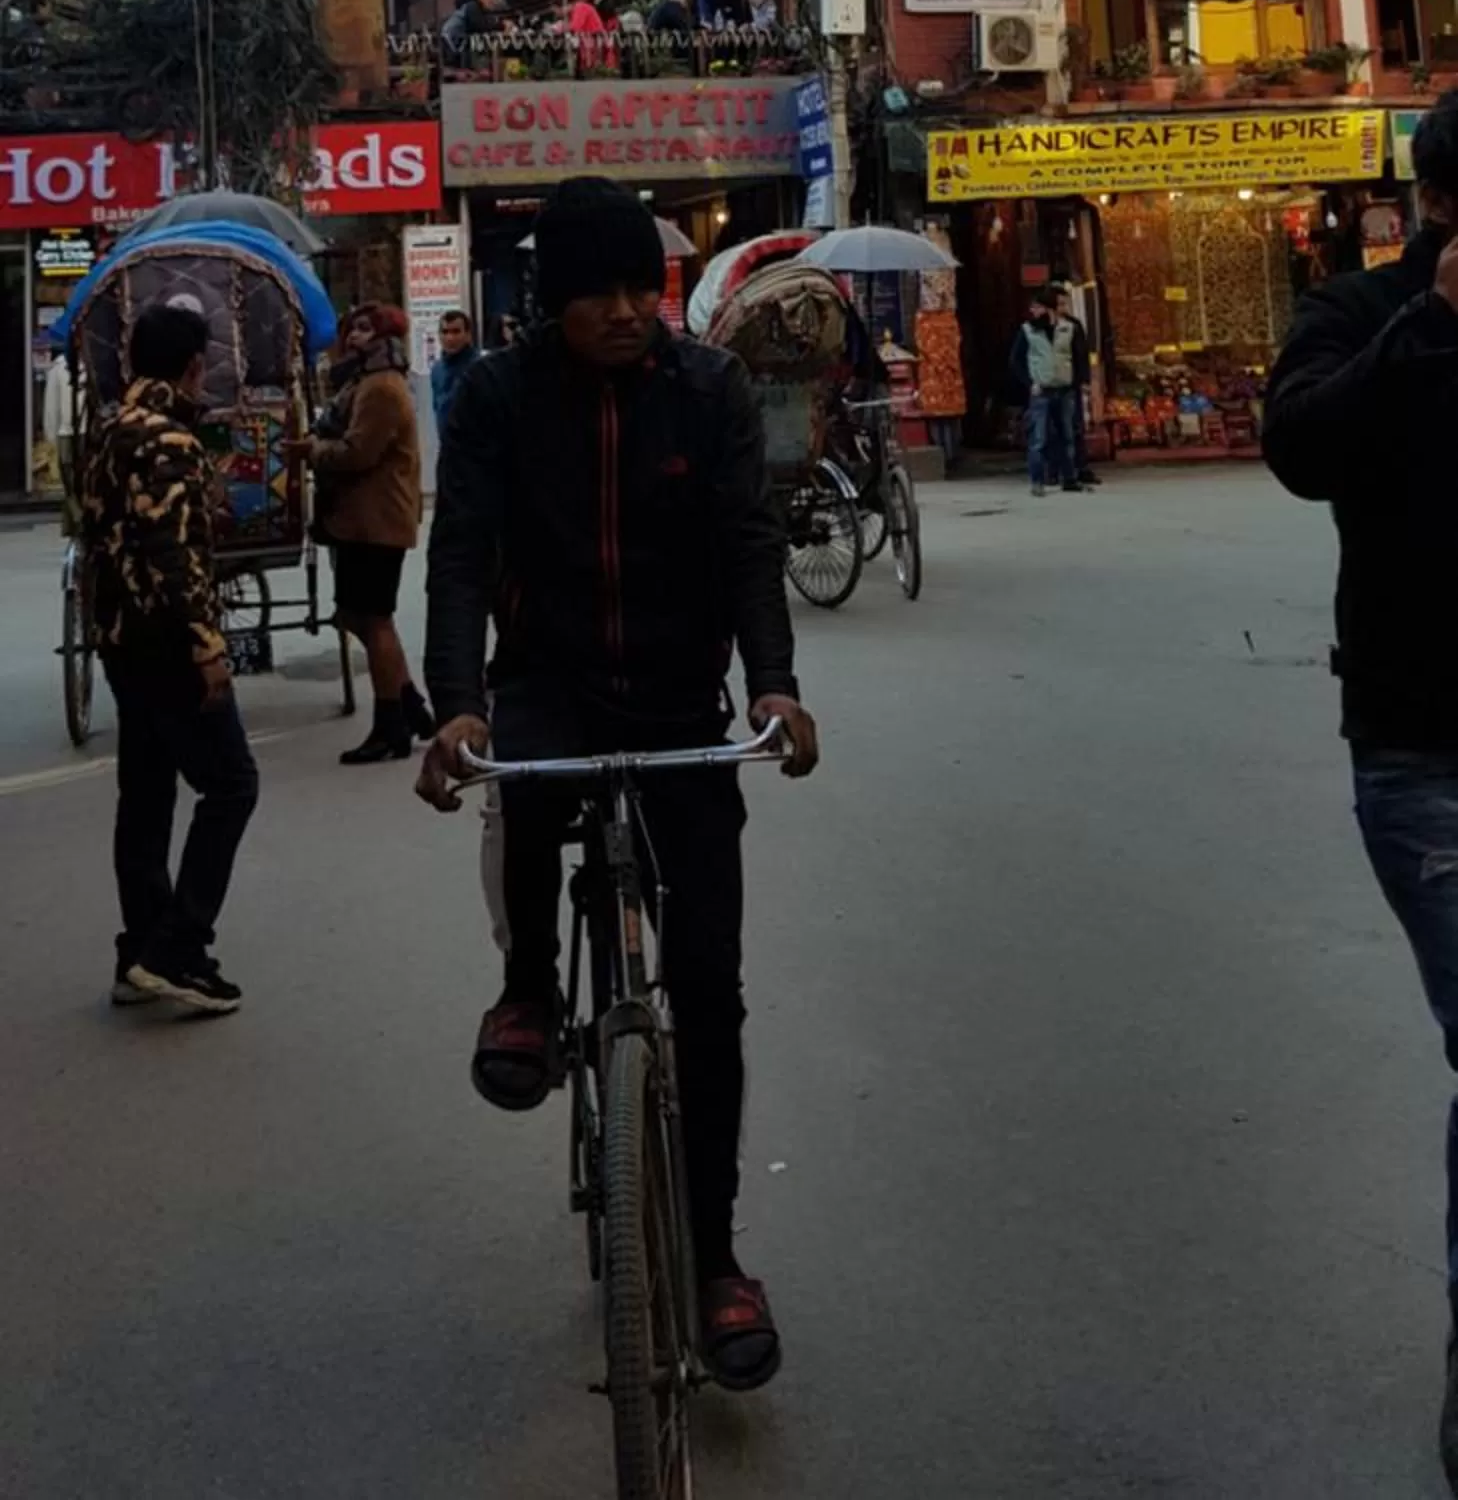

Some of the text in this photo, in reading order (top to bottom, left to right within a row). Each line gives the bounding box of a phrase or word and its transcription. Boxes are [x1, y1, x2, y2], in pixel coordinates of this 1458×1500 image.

[473, 87, 774, 132] BON APPETIT
[447, 140, 535, 167] CAFE
[544, 140, 574, 165] &
[583, 134, 799, 165] RESTAURANT
[977, 123, 1221, 157] HANDICRAFTS
[1231, 115, 1349, 144] EMPIRE
[0, 142, 117, 206] Hot
[1028, 168, 1044, 178] A
[1052, 161, 1173, 178] COMPLETE
[1183, 157, 1252, 171] STORE
[1263, 155, 1307, 166] FOR
